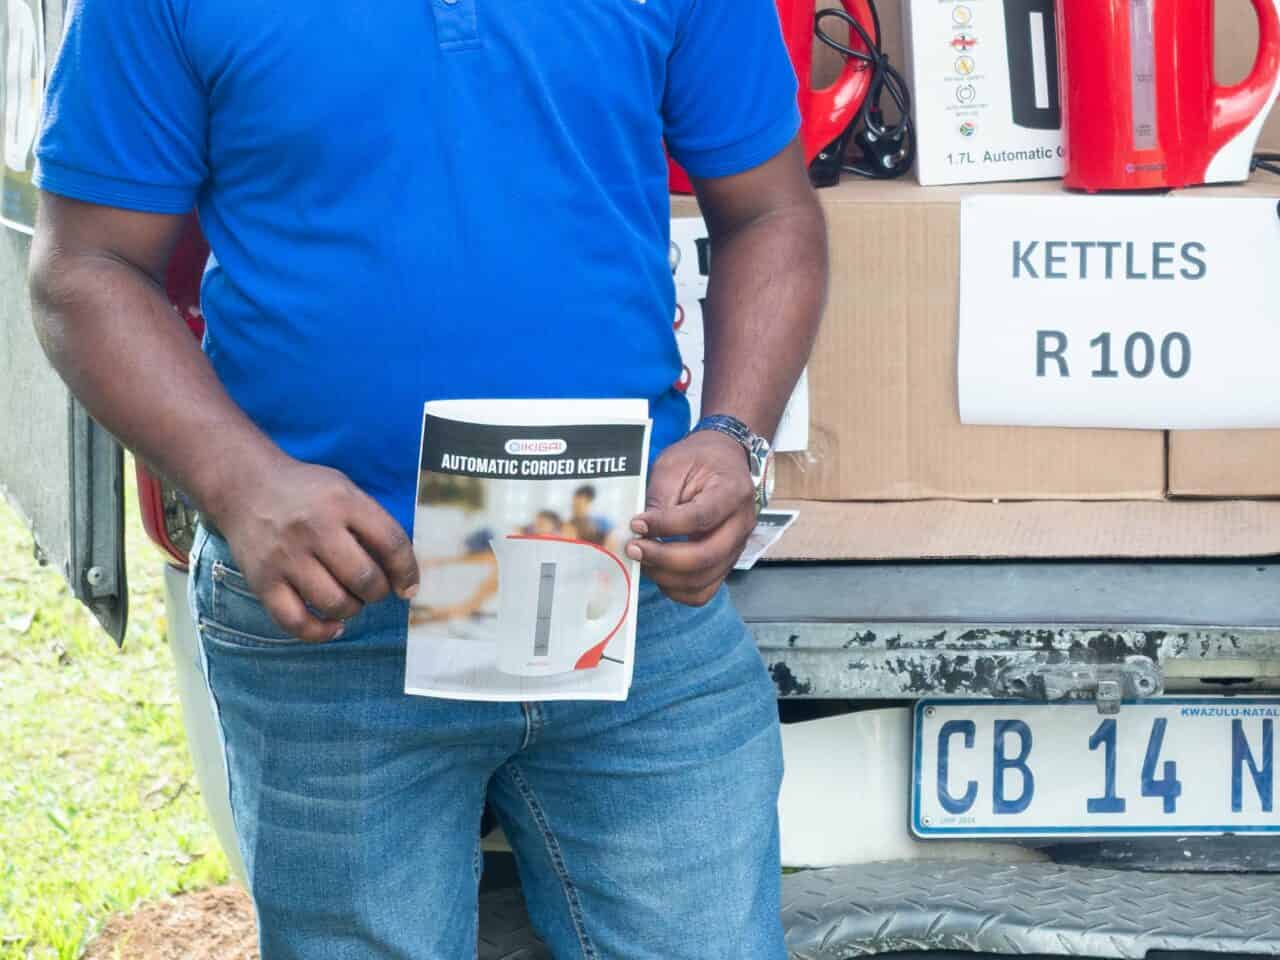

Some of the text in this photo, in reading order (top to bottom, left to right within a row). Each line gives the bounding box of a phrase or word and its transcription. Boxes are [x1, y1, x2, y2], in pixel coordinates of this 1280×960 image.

[983, 146, 1054, 163] Automatic
[1012, 239, 1207, 281] KETTLES
[1036, 329, 1192, 379] R 100
[441, 453, 628, 476] AUTOMATIC CORDED KETTLE
[1180, 707, 1280, 718] KWAZULU-NATAL
[936, 719, 1035, 814] CB
[1086, 718, 1182, 814] 14
